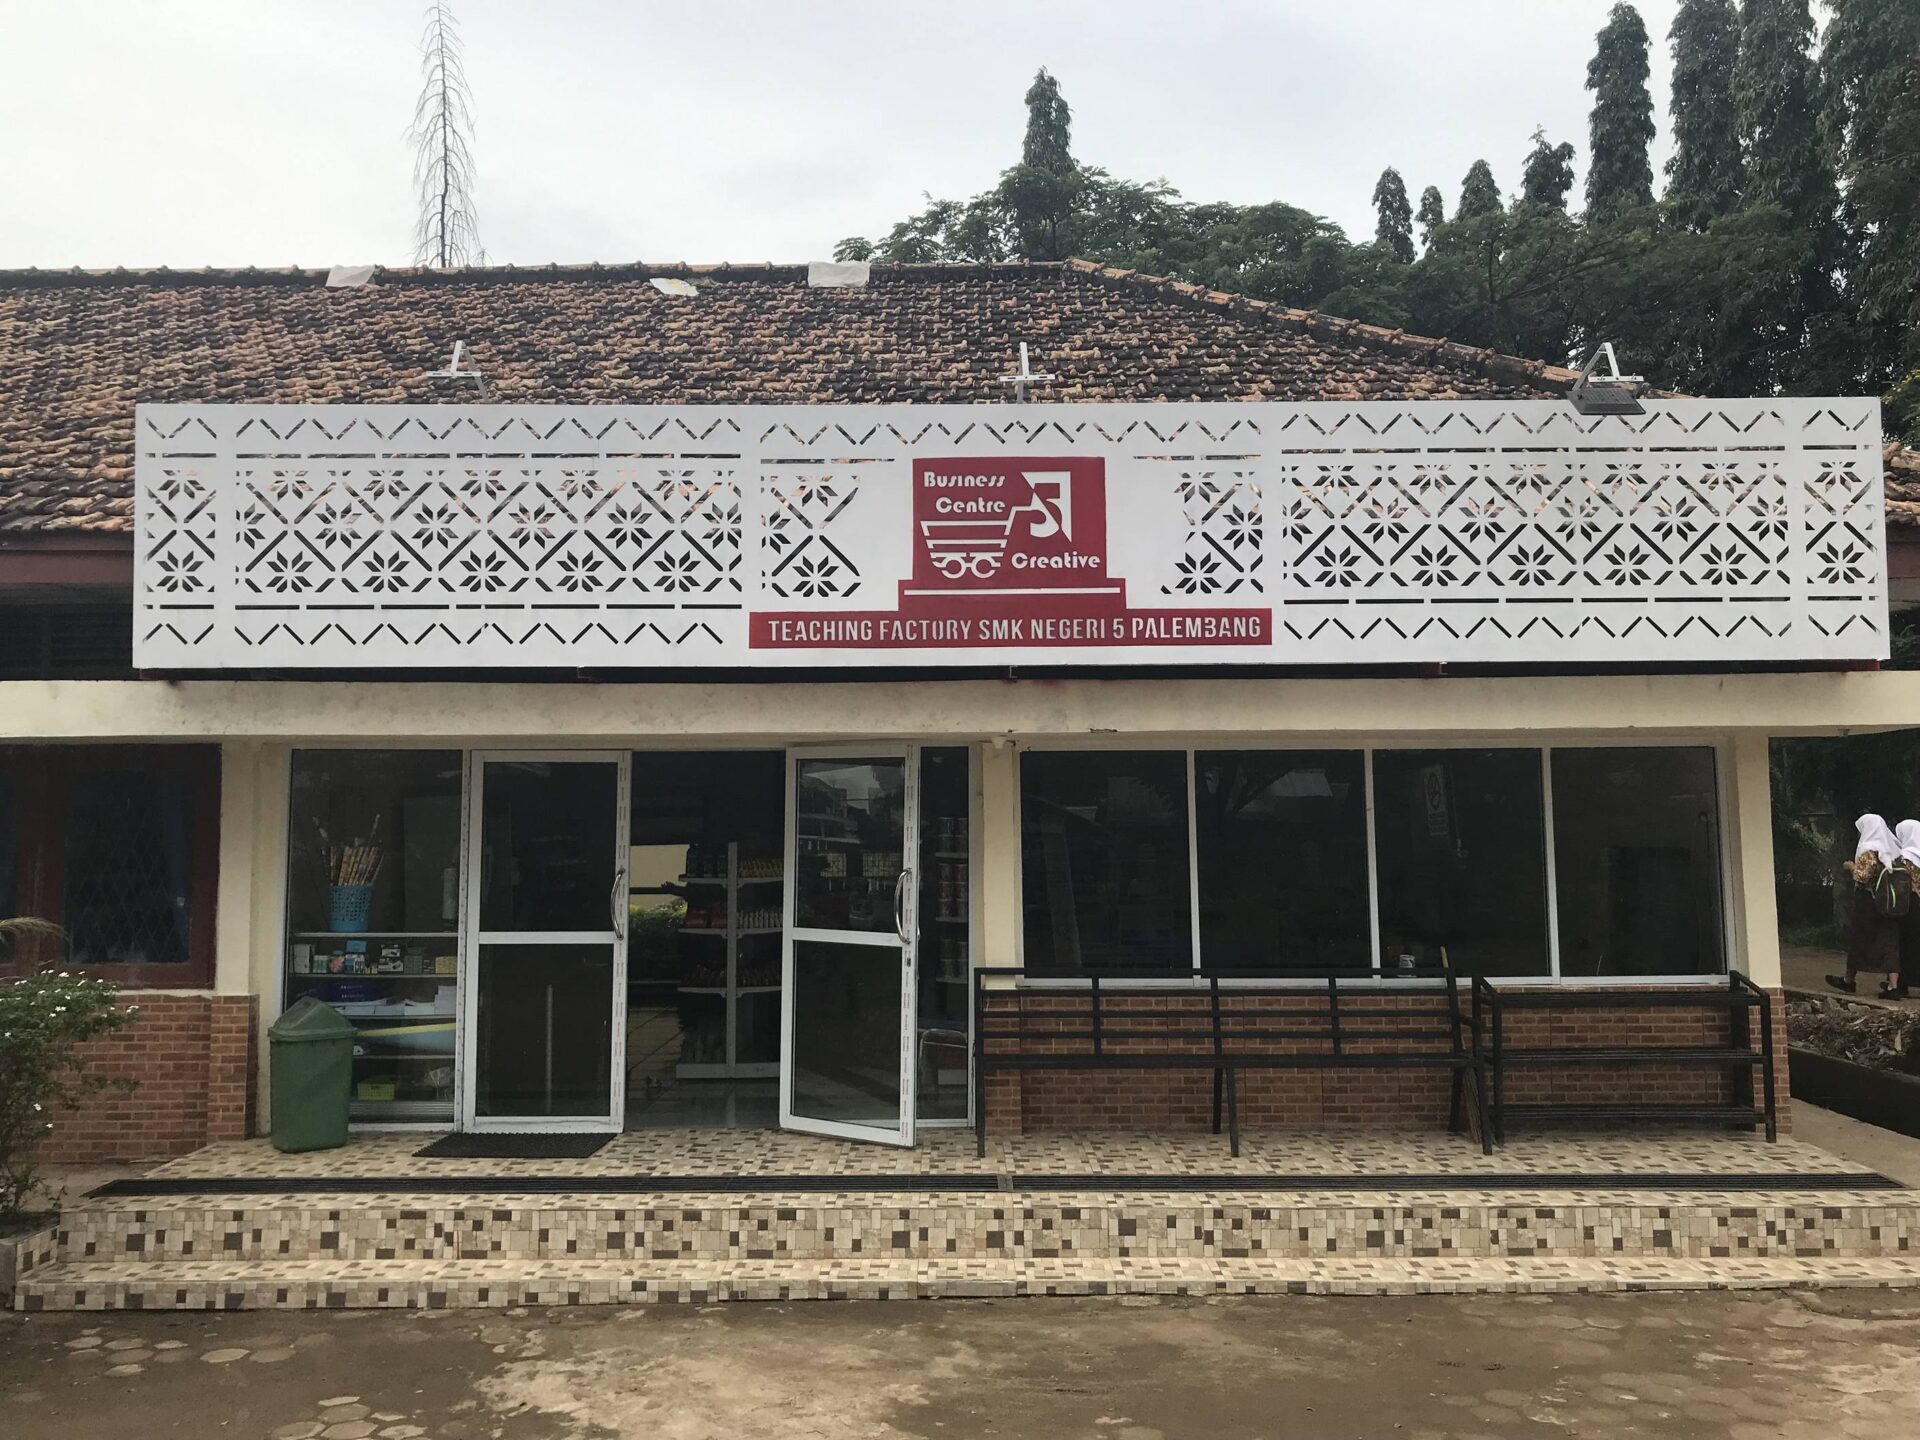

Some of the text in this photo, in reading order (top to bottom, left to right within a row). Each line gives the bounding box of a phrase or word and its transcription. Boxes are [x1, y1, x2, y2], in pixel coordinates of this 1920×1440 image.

[923, 471, 1006, 488] Business
[935, 496, 1006, 514] Centre
[1011, 551, 1101, 569] Creative
[768, 620, 873, 641] TEACHING
[879, 619, 972, 640] FACTORY
[979, 618, 1023, 640] SMK
[1030, 618, 1105, 640] NEGERI
[1112, 618, 1125, 639] 5
